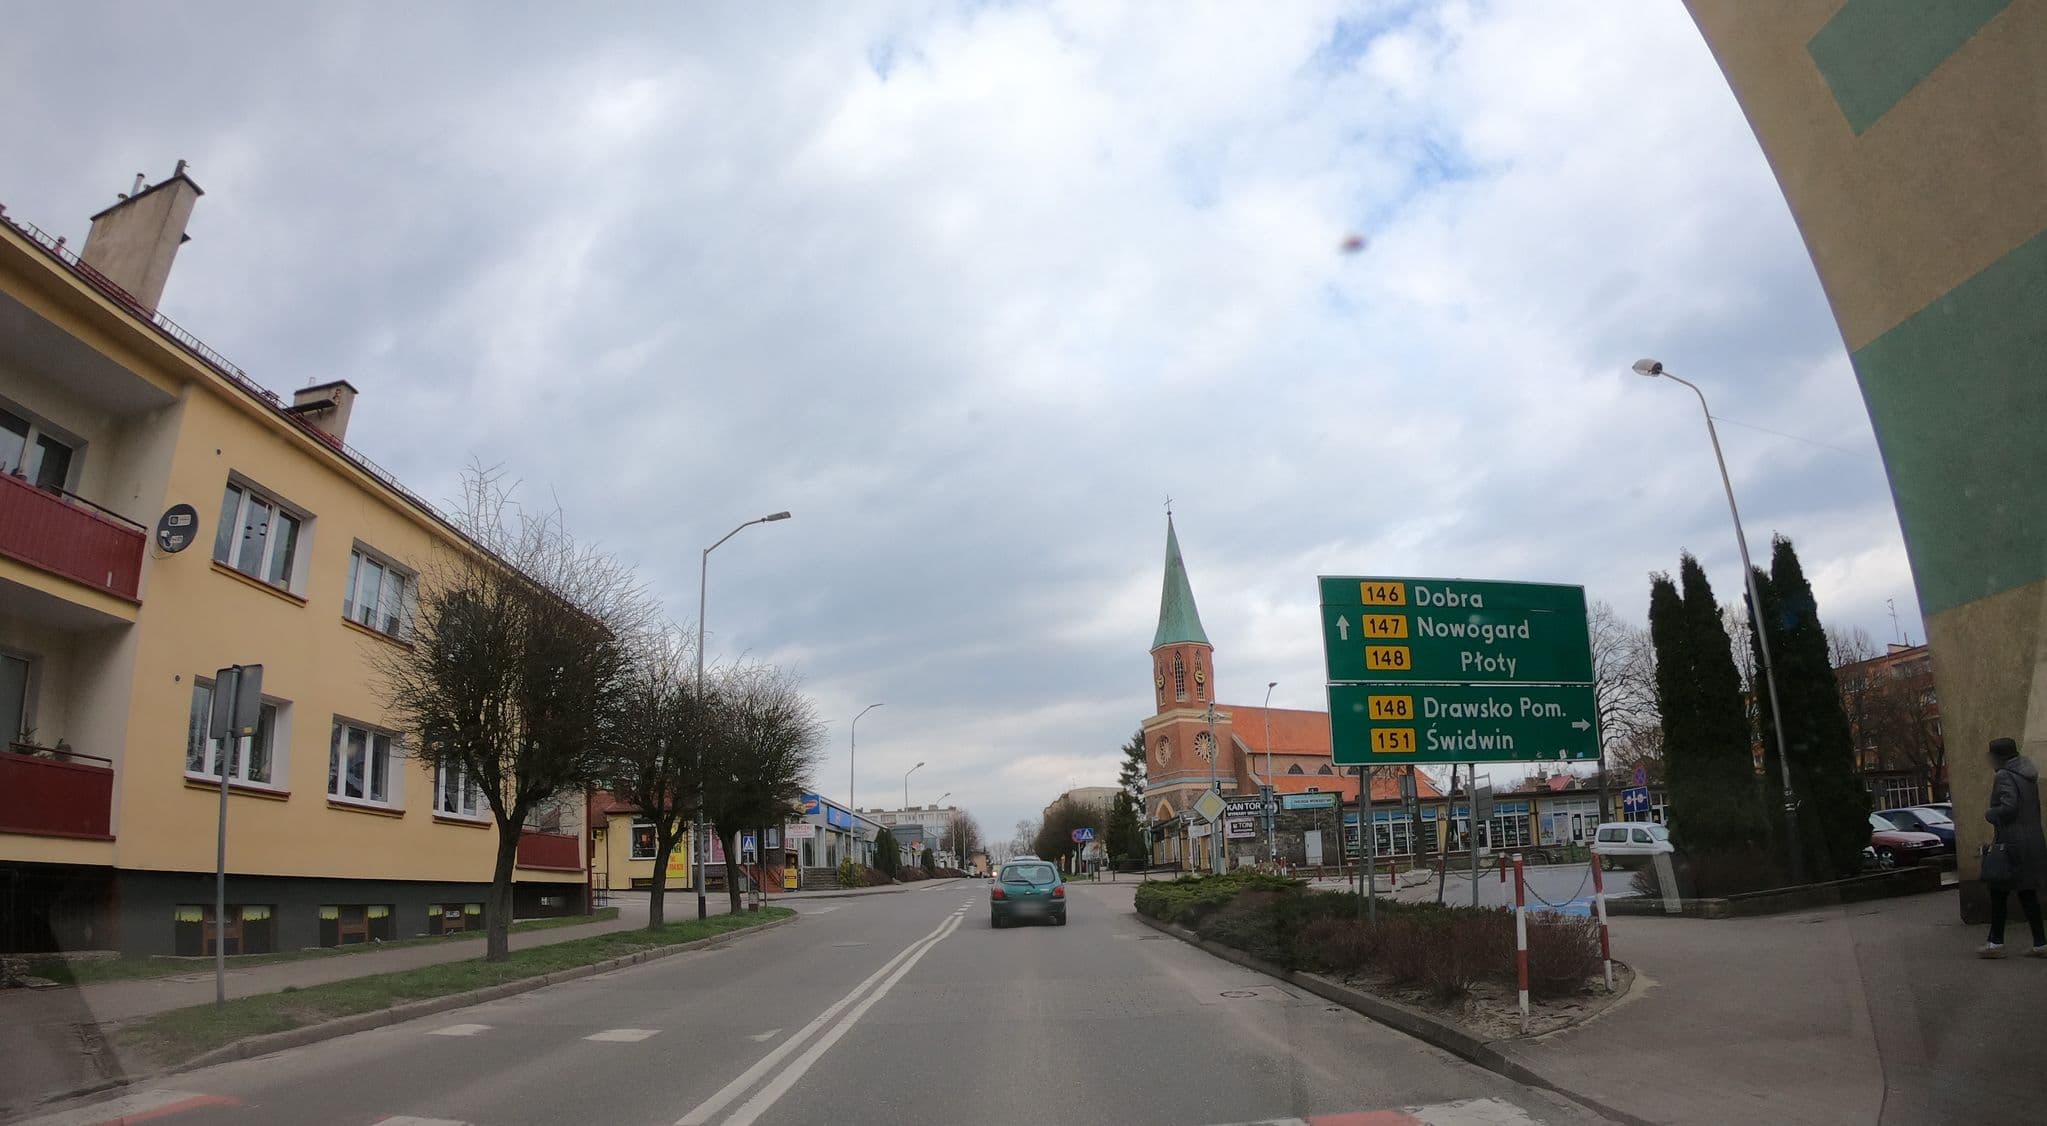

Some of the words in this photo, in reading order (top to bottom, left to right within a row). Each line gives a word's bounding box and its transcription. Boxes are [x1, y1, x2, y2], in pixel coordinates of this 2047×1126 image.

[1367, 586, 1399, 602] 146
[1414, 586, 1483, 608] Dobra
[1369, 618, 1400, 634] 147
[1417, 616, 1530, 644] Nowogard
[1372, 650, 1404, 667] 148
[1461, 651, 1516, 678] Płoty
[1375, 700, 1407, 716] 148
[1423, 697, 1513, 718] Drawsko
[1519, 697, 1567, 717] Pom.
[1378, 732, 1410, 749] 151
[1426, 722, 1514, 751] Świdwin
[1226, 802, 1261, 811] KANTOR
